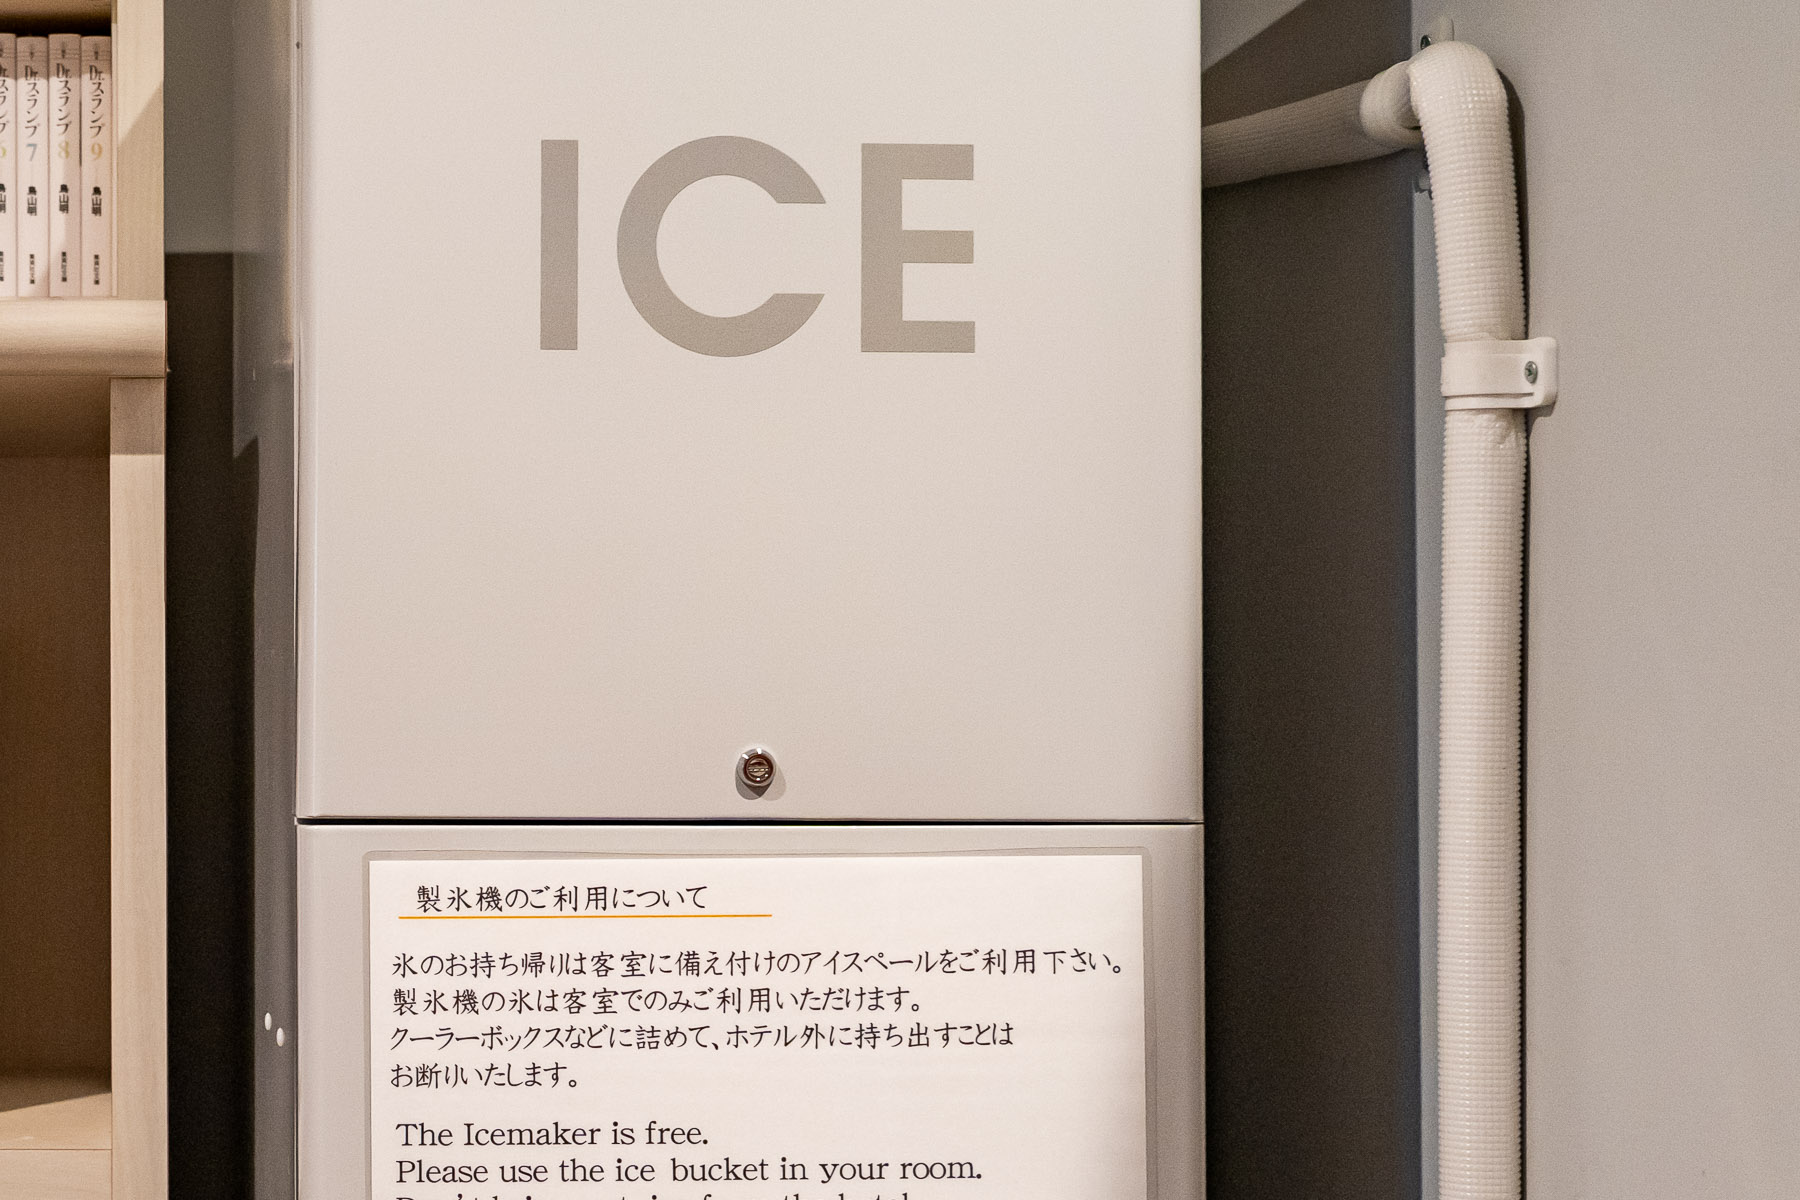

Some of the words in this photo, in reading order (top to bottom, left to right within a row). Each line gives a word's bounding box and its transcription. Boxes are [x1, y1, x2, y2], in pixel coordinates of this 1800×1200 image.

[26, 143, 38, 161] 7
[58, 141, 70, 159] 8
[91, 143, 103, 161] 9
[540, 135, 976, 358] ICE
[416, 884, 708, 913] 製氷機のご利用について
[392, 947, 1122, 979] 氷のお持ち帰りは客室に備え付けのアイスペールをご利用下さい。
[392, 985, 921, 1017] 製氷機の氷は客室でのみご利用いただけます。
[389, 1021, 1014, 1051] クーラーボックスなどに詰めて、ホテル外に持ち出すことは
[389, 1061, 578, 1089] お断りいたします。
[395, 1122, 454, 1148] The
[463, 1121, 601, 1147] Icemaker
[610, 1121, 635, 1146] is
[644, 1120, 709, 1146] free.
[395, 1159, 489, 1184] Please
[499, 1164, 550, 1184] use
[558, 1158, 606, 1183] the
[614, 1158, 656, 1183] ice
[670, 1158, 770, 1182] bucket
[778, 1156, 809, 1181] in
[818, 1161, 890, 1184] your
[899, 1160, 983, 1180] room.
